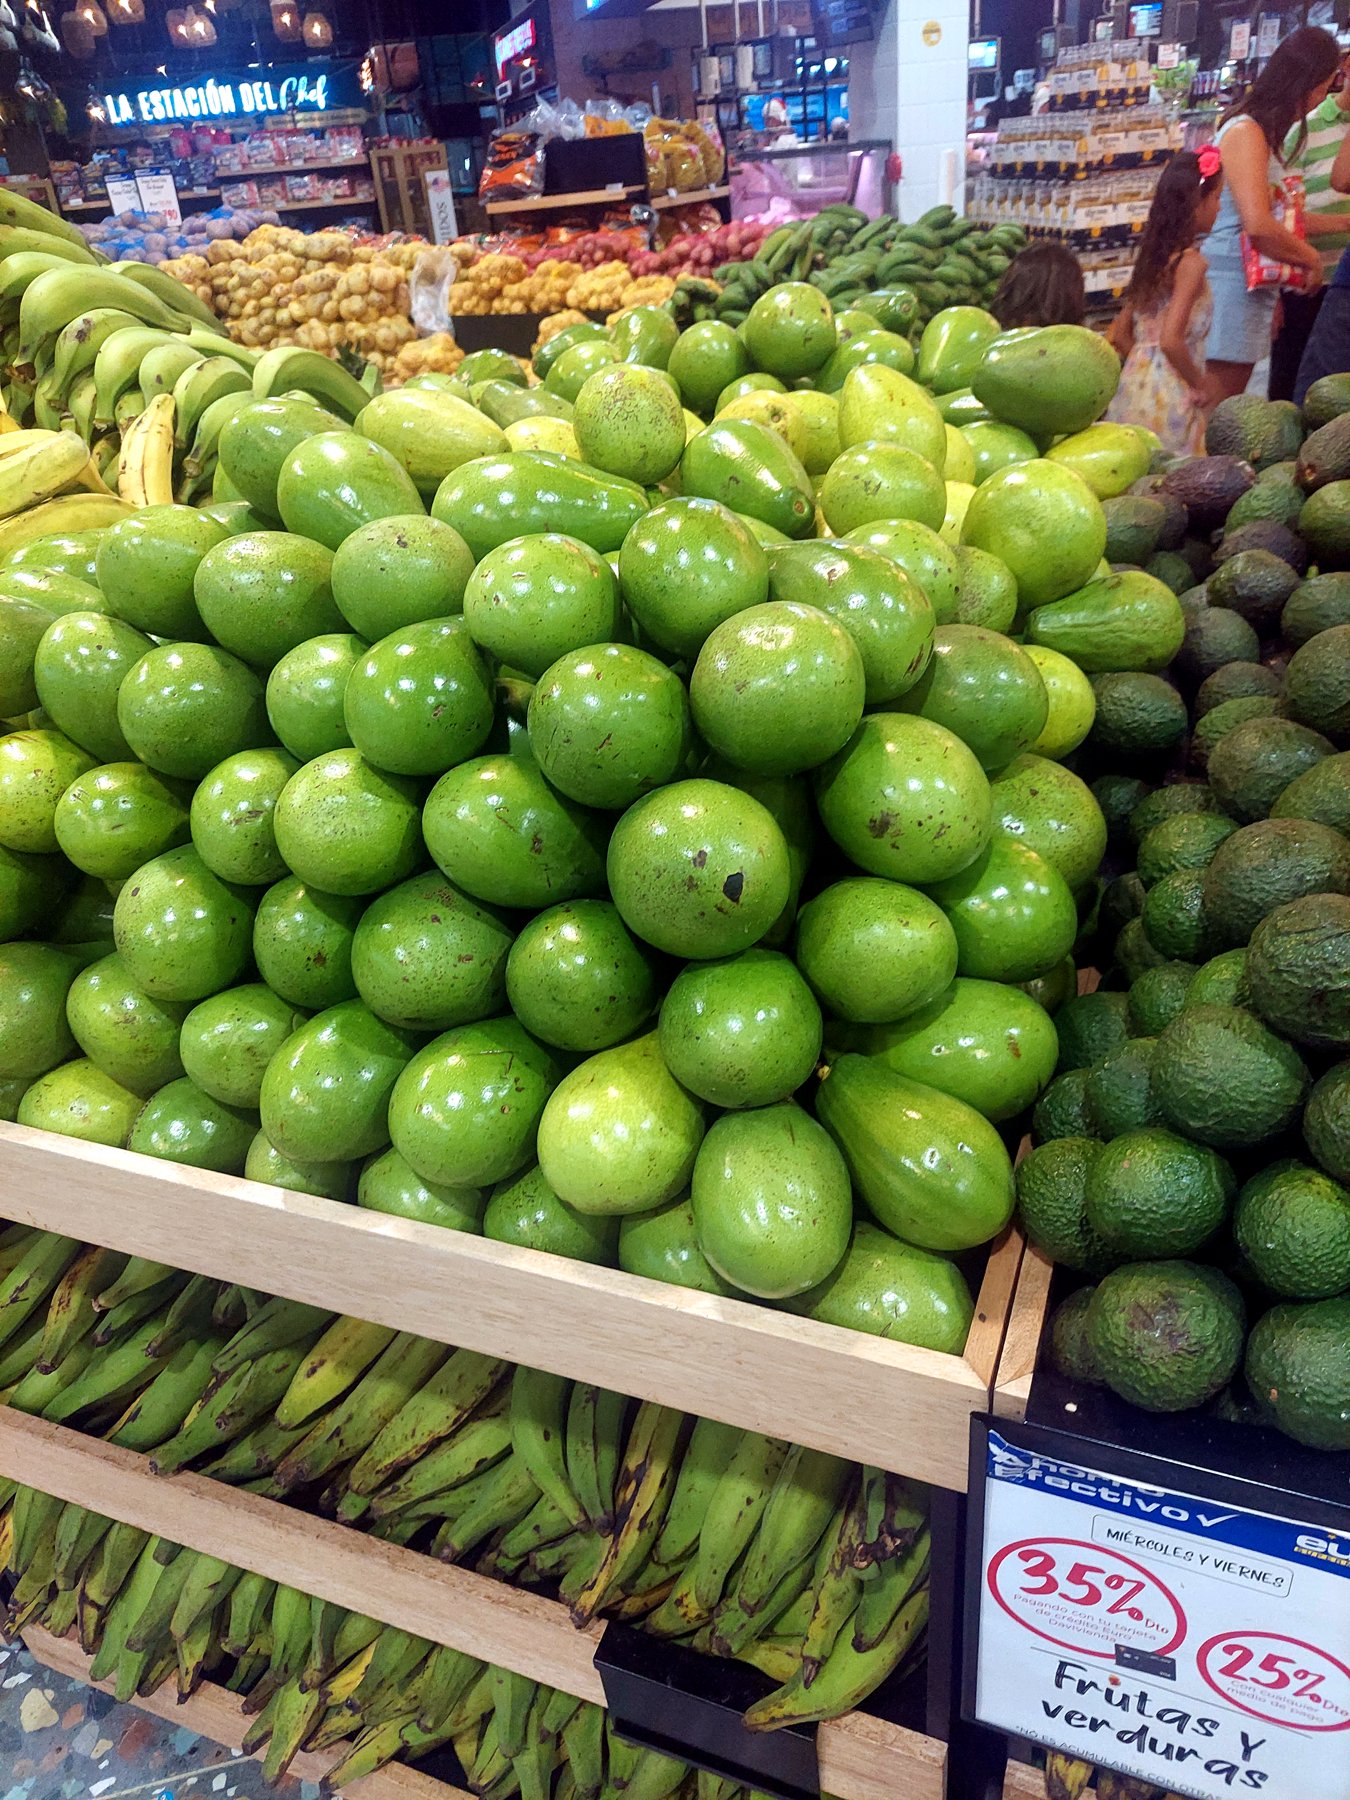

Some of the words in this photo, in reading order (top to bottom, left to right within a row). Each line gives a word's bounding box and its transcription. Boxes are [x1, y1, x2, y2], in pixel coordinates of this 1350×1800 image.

[105, 93, 135, 124] LA
[138, 78, 236, 121] ESTACIÓN
[239, 81, 278, 112] DEL
[279, 74, 329, 111] Chef
[994, 1463, 1190, 1522] Efectivo
[1106, 1527, 1194, 1562] MIÉRCOLES
[1198, 1554, 1210, 1566] Y
[1213, 1558, 1285, 1588] VIERNES
[1018, 1549, 1146, 1621] 35%
[1145, 1618, 1169, 1634] Dto
[1035, 1608, 1051, 1616] de
[1048, 1618, 1117, 1643] Davivienda
[1071, 1610, 1094, 1621] con
[1099, 1618, 1111, 1627] tu
[1115, 1623, 1157, 1641] tarjeta
[1218, 1644, 1326, 1703] 25%
[1322, 1700, 1349, 1717] Dto
[1226, 1687, 1267, 1703] medio
[1270, 1701, 1286, 1710] de
[1290, 1708, 1325, 1723] pago
[1260, 1689, 1319, 1713] cualquier
[1054, 1660, 1221, 1738] Frutas
[1240, 1730, 1267, 1763] Y
[1041, 1699, 1270, 1790] verduras
